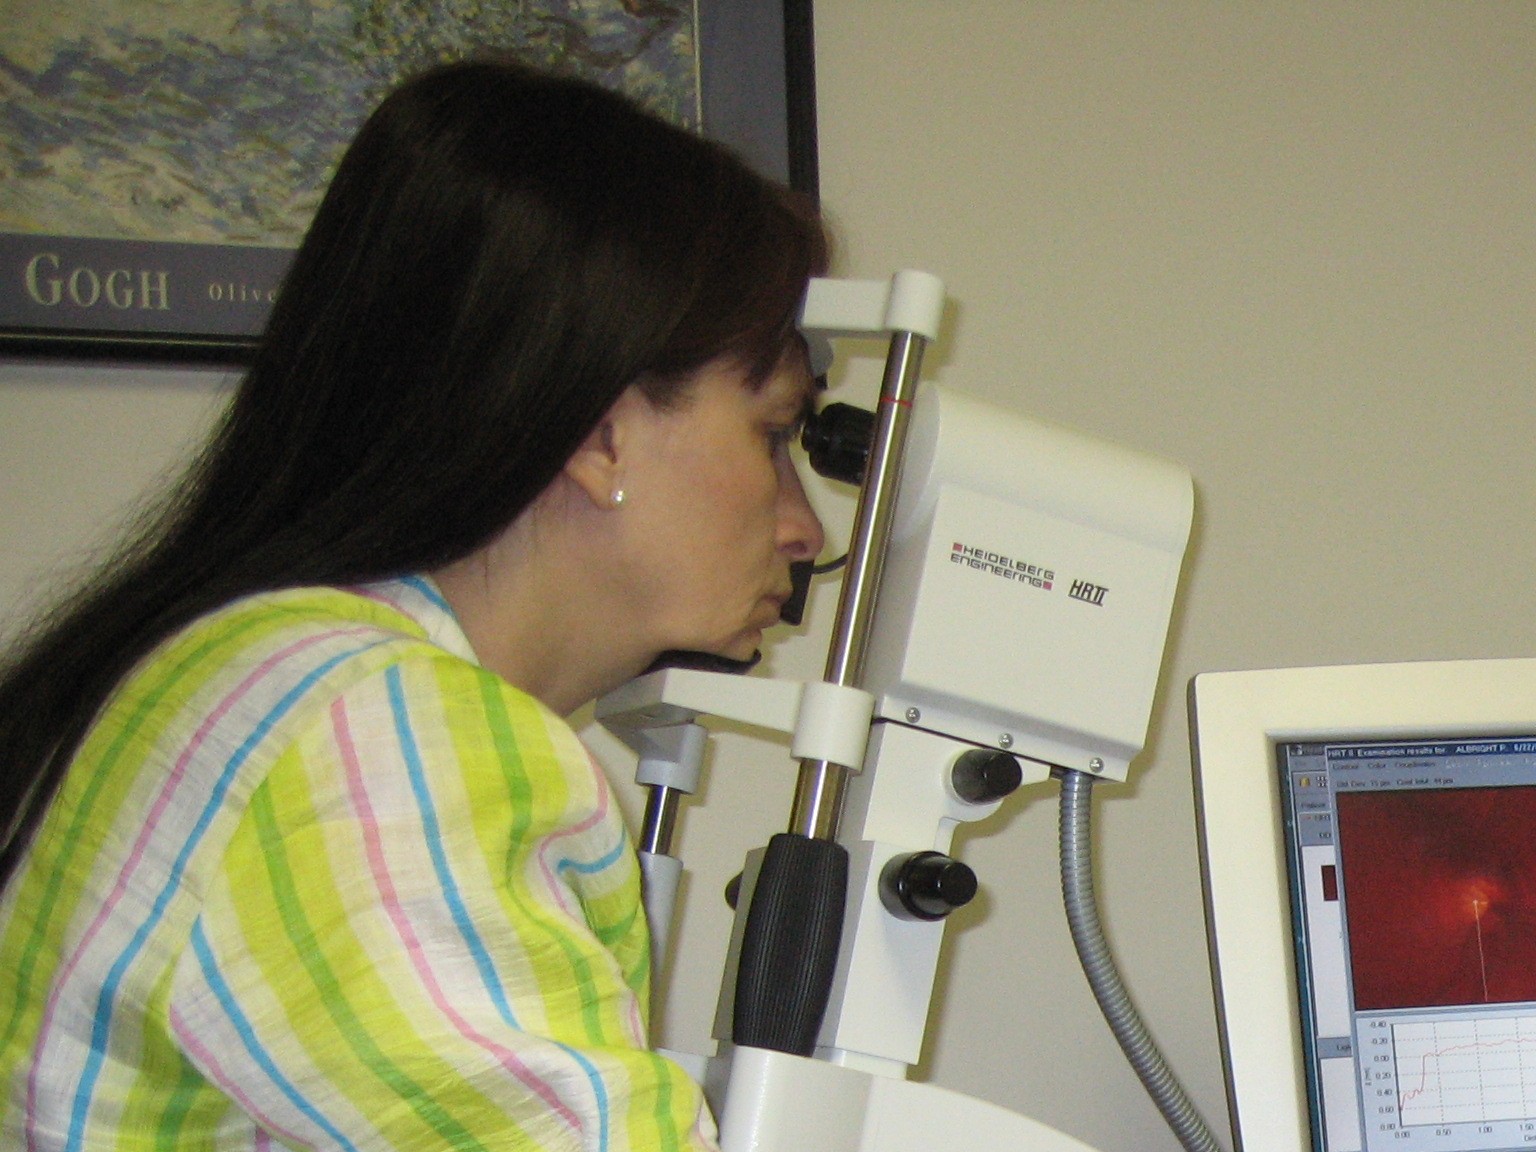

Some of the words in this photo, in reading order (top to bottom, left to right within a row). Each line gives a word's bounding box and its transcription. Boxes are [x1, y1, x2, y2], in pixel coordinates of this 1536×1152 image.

[25, 252, 171, 311] GOGH
[950, 552, 1043, 589] ENGINEERING
[962, 545, 1055, 581] HEIDELBERG
[1455, 745, 1499, 754] ALBRIGHT
